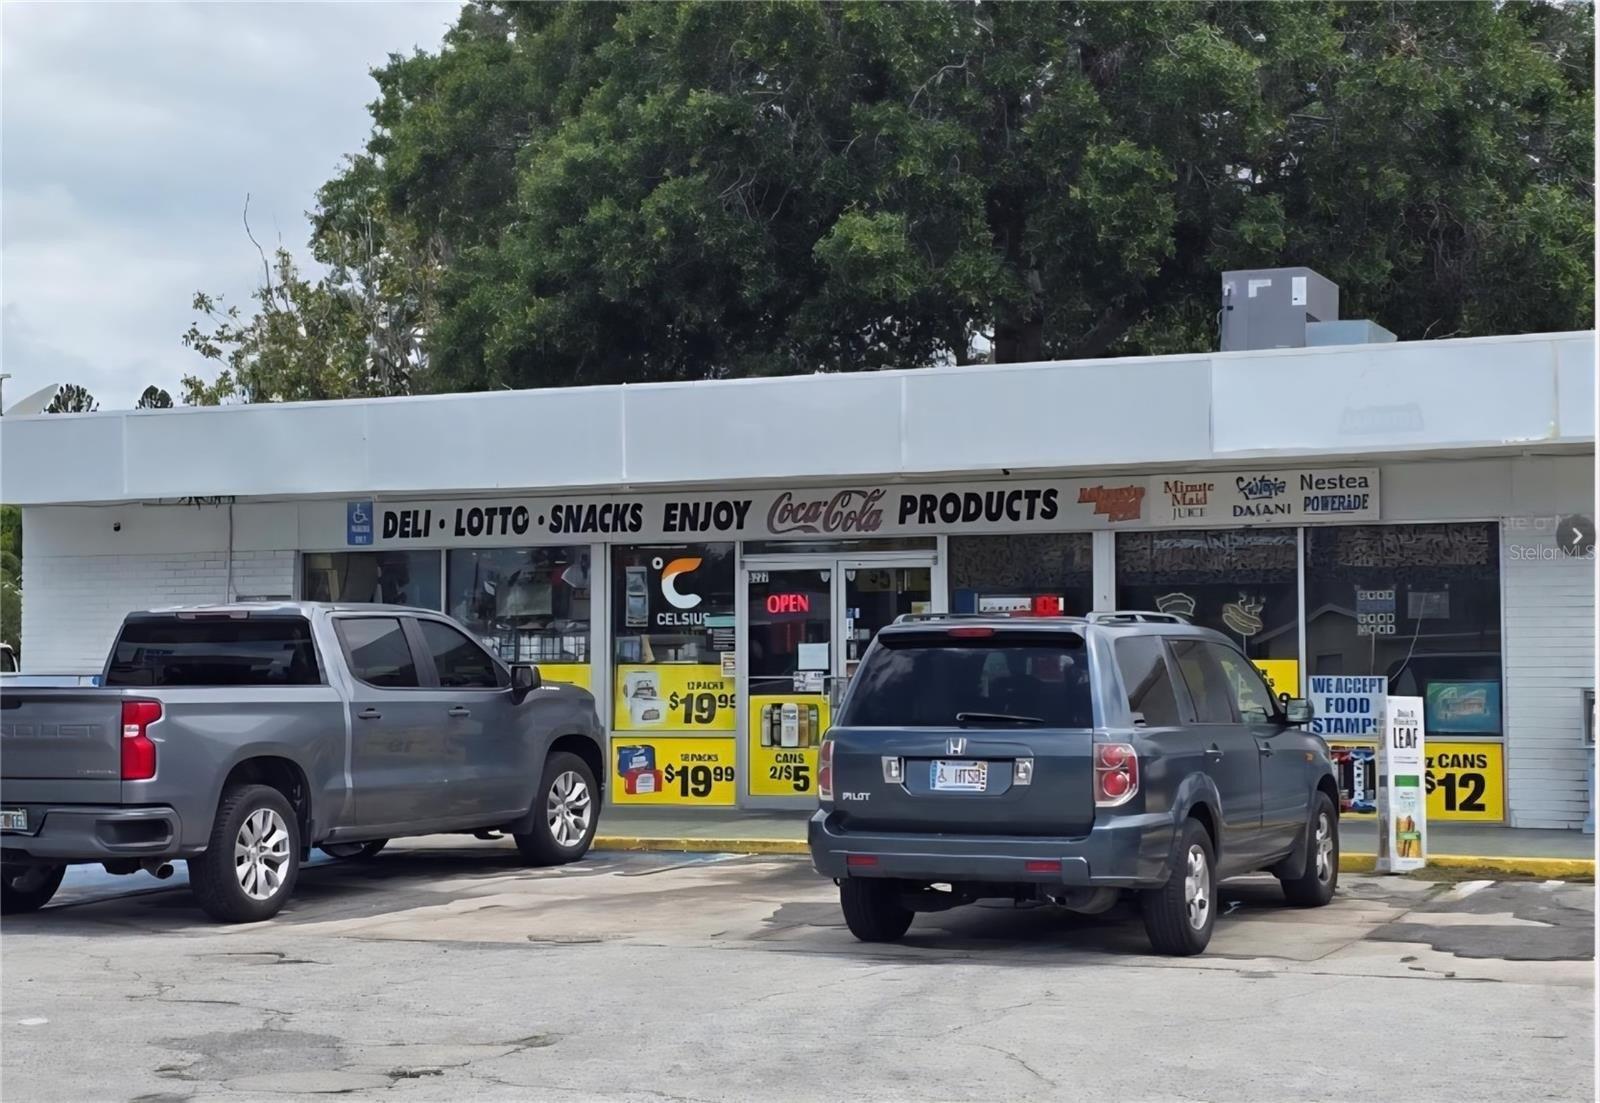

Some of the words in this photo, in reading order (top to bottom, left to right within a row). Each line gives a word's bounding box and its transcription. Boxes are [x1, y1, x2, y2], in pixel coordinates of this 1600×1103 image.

[1300, 473, 1369, 490] Nestea
[382, 509, 431, 539] DELI
[454, 506, 530, 537] LOTTO
[549, 503, 643, 533] SNACKS
[663, 500, 752, 532] ENJOY
[899, 488, 1059, 525] PRODUCTS
[767, 594, 809, 614] OPEN
[1312, 677, 1333, 693] WE
[1335, 677, 1385, 693] ACCEPT
[1325, 697, 1370, 713] FOOD
[1393, 727, 1418, 749] LEAF
[775, 753, 805, 764] CANS
[1438, 753, 1488, 769] CANS
[842, 792, 870, 800] PILOT
